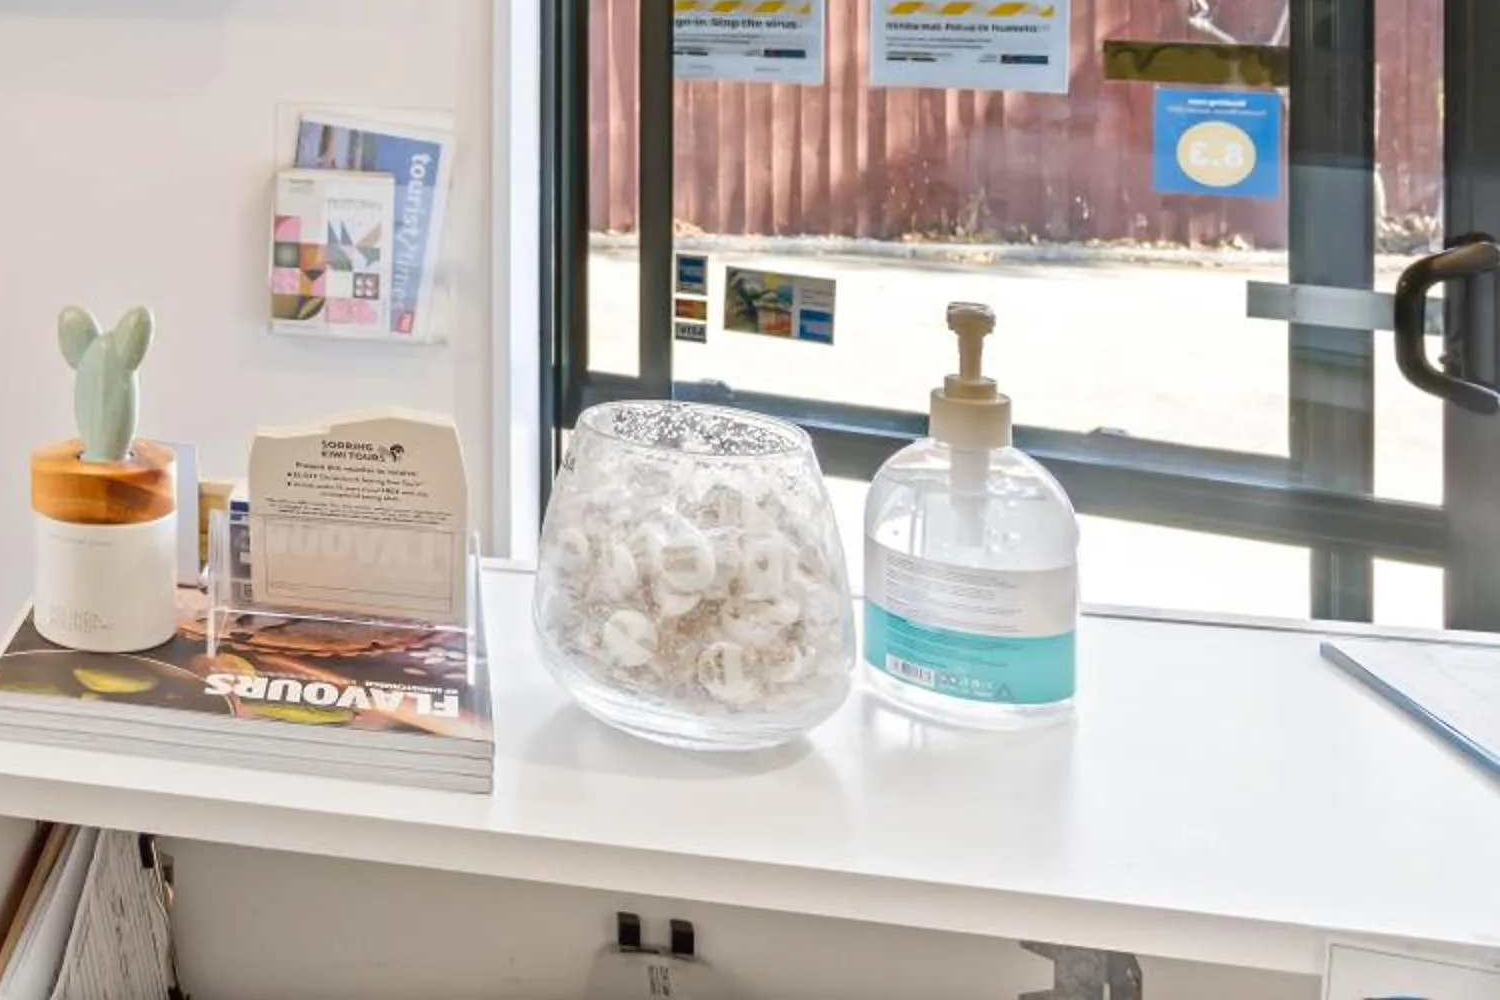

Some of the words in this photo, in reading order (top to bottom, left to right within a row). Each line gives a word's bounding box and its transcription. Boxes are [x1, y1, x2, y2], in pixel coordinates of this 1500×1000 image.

[742, 18, 762, 28] the
[347, 451, 385, 463] TOURS
[204, 673, 459, 718] FLAVOURS
